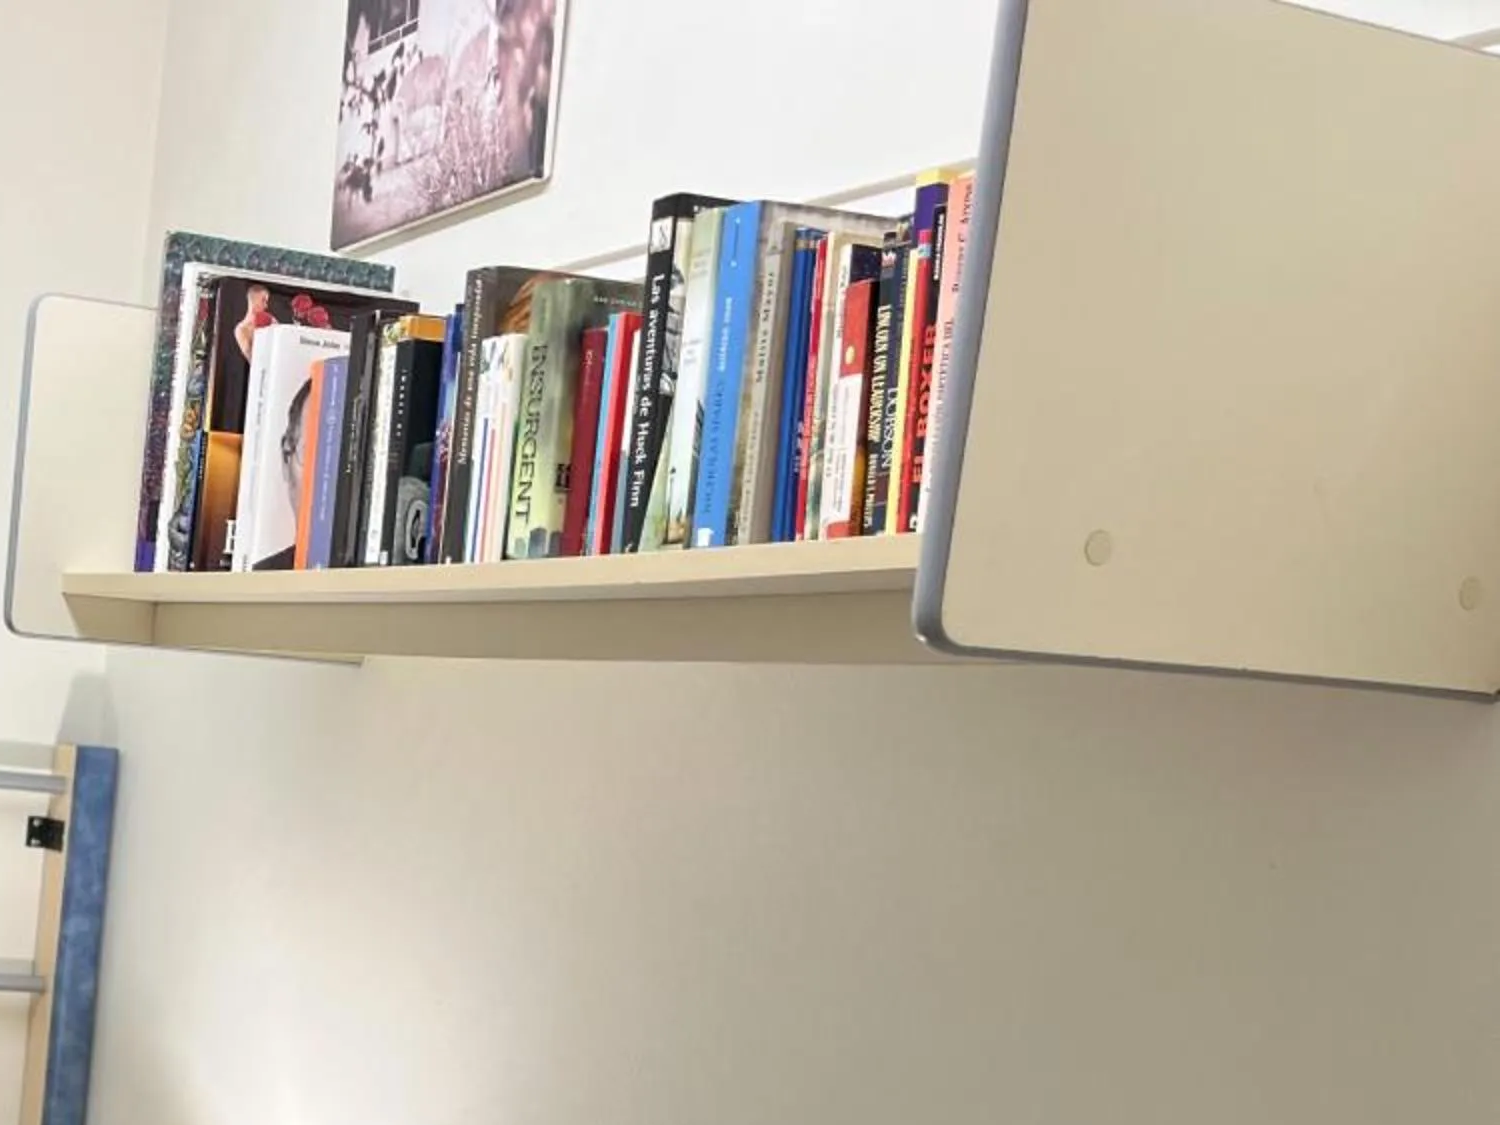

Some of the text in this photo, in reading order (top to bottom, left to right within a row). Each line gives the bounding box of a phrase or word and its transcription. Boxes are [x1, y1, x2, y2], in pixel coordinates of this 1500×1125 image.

[515, 345, 546, 521] INSURGENT
[630, 274, 665, 507] Las aventuras de Huck Finn
[867, 304, 891, 442] LINCOLN ON LEADERSHIP
[881, 387, 899, 468] DOBSON
[915, 323, 936, 438] BOXER
